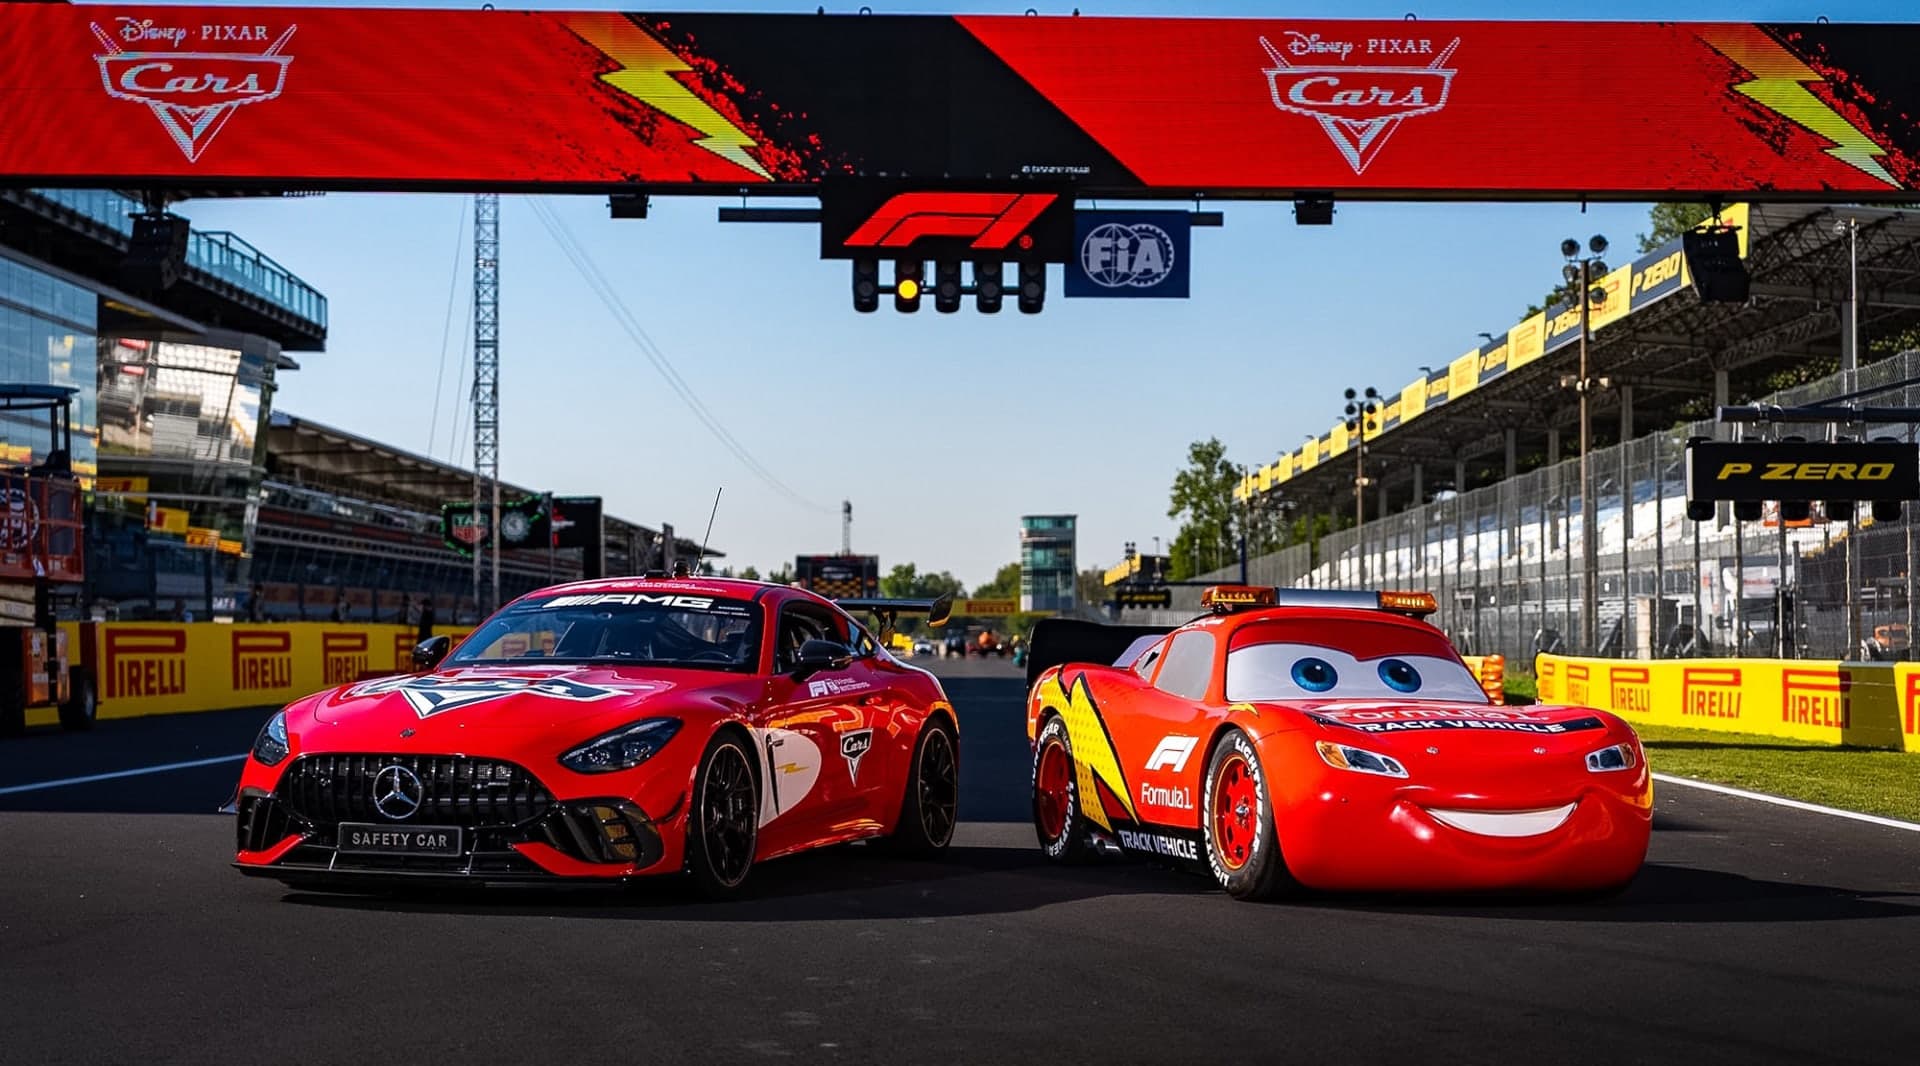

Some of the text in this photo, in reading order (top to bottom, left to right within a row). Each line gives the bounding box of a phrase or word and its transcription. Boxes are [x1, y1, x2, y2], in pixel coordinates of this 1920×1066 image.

[201, 25, 268, 40] PIXAR
[1367, 39, 1433, 54] PIXAR
[120, 62, 265, 93] Cars
[1288, 76, 1429, 106] Cars
[1631, 272, 1643, 298] P
[1642, 250, 1682, 292] ZERO
[1717, 463, 1895, 480] P ZERO
[598, 594, 714, 609] AMG
[105, 628, 186, 699] PIRELLI
[232, 630, 292, 690] PIRELLI
[1610, 667, 1650, 712] PIRELLI
[1682, 668, 1741, 718] PIRELLI
[1782, 668, 1852, 729] PIRELLI
[1355, 720, 1566, 733] TRACK VEHICLE
[843, 736, 868, 754] Cars
[1144, 735, 1199, 772] F1
[352, 832, 448, 847] SAFETY CAR
[1118, 829, 1198, 860] TRACK VEHICLE
